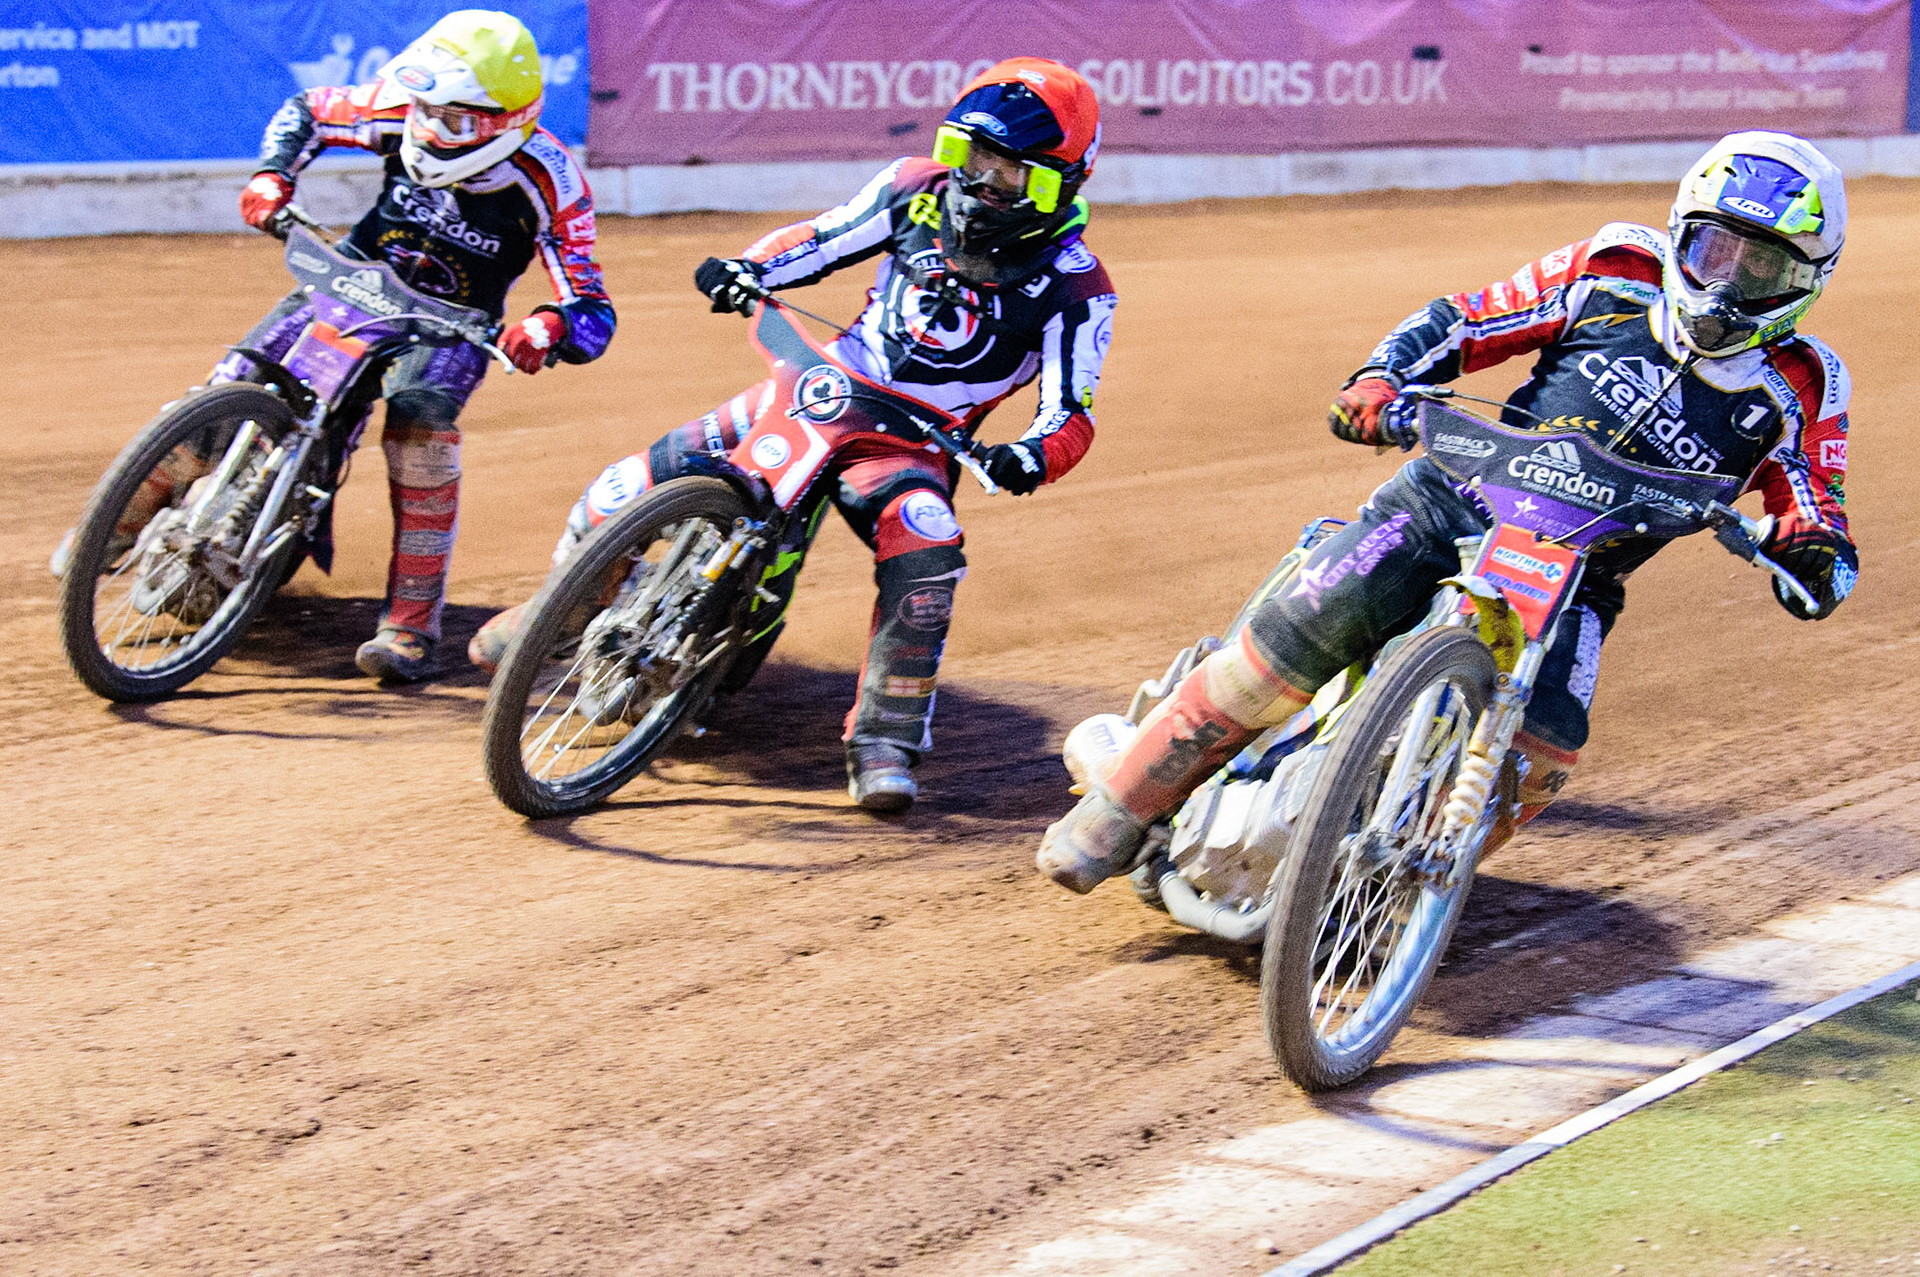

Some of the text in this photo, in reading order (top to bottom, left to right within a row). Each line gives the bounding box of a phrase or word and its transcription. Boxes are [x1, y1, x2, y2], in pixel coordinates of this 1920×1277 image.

[82, 23, 131, 49] and
[137, 21, 200, 49] MOT
[392, 184, 500, 253] Crendon
[1735, 199, 1771, 216] Arai
[332, 276, 402, 315] Crendon
[1578, 352, 1718, 474] Crendon
[1590, 385, 1632, 422] TIMBER
[1740, 404, 1770, 430] 1
[1508, 455, 1616, 505] Crendon
[1356, 511, 1413, 557] AUCTON
